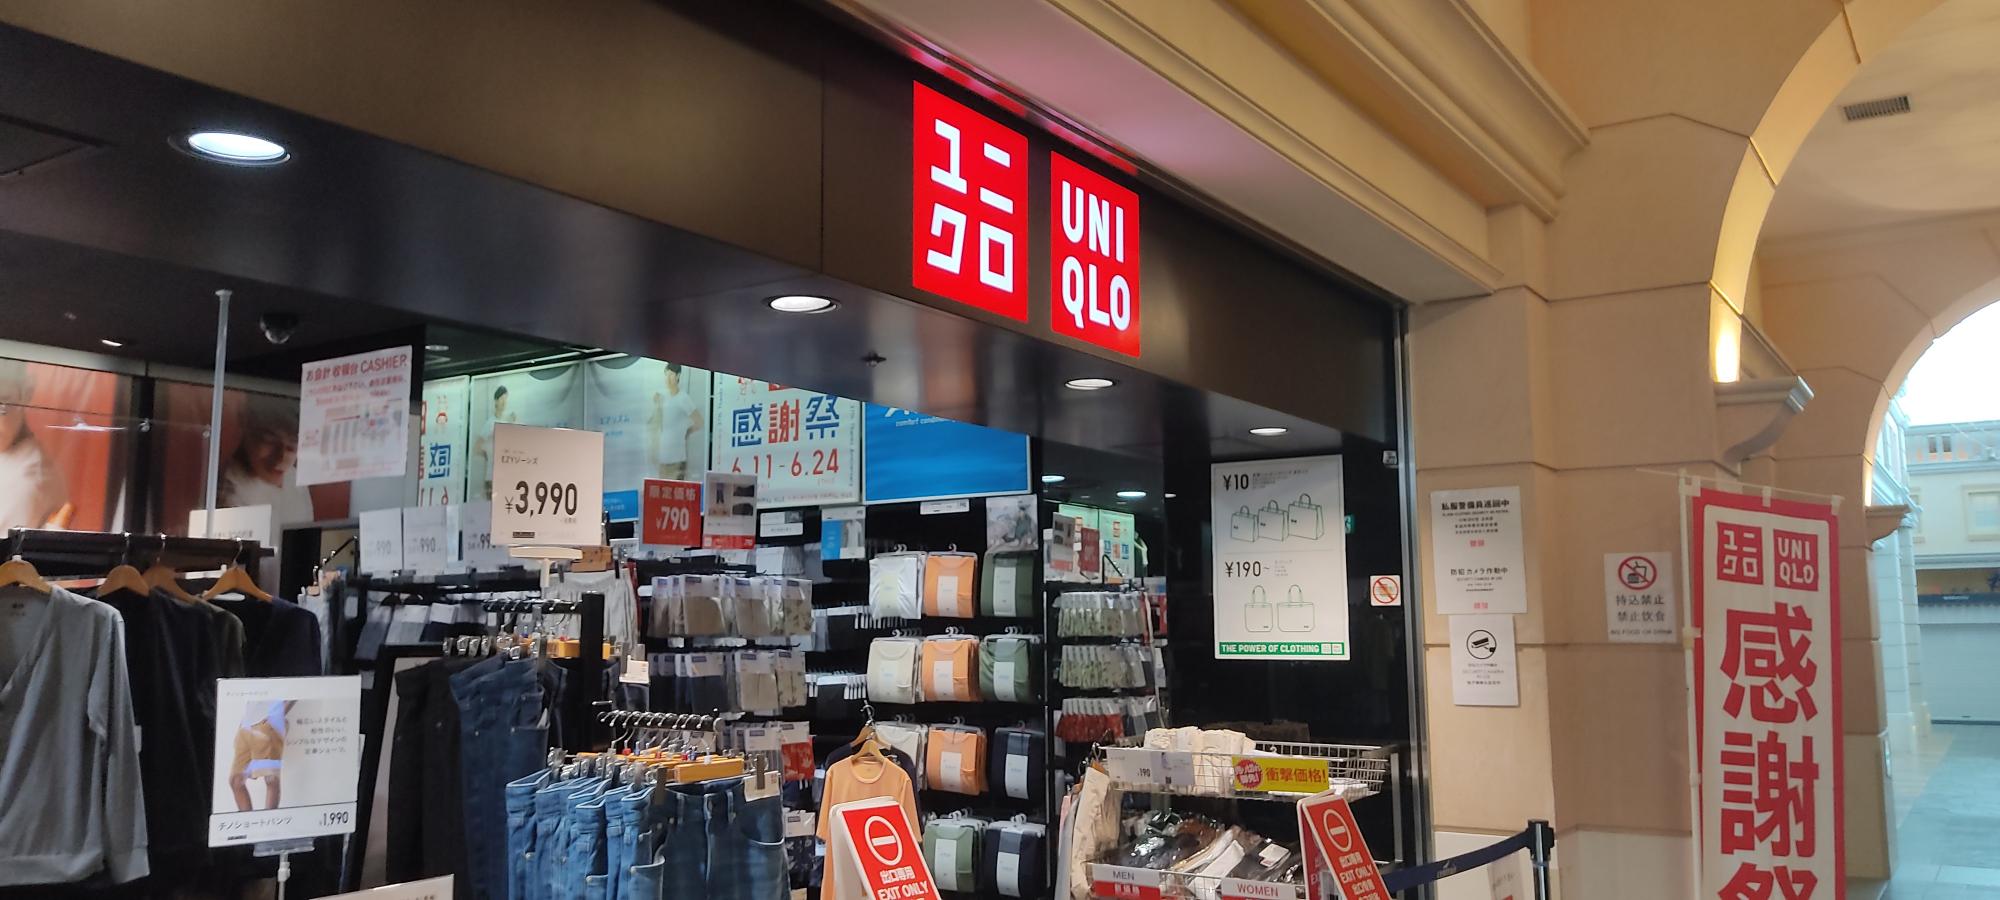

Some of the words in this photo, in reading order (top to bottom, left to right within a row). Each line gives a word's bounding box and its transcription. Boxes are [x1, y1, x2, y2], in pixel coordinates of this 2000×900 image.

[931, 119, 1013, 214] ユニ
[1062, 181, 1124, 263] UNI
[927, 203, 1013, 293] クロ
[1062, 256, 1130, 331] QLO
[732, 395, 840, 448] 感謝祭
[1223, 473, 1249, 491] ¥10
[505, 481, 578, 518] ¥3,990
[656, 506, 690, 531] ¥790
[1723, 530, 1758, 552] ユニ
[1777, 536, 1811, 562] UNI
[1723, 556, 1758, 578] クロ
[1779, 561, 1815, 587] QLO
[1222, 644, 1237, 653] THE
[1238, 644, 1267, 653] POWER
[1268, 643, 1279, 653] OF
[1280, 643, 1319, 653] CLOTHING
[217, 816, 293, 831] チノショートパンツ
[1112, 870, 1135, 880] MEN
[1355, 864, 1374, 879] ONLY
[878, 886, 901, 900] EXIT
[902, 881, 929, 897] ONLY
[1237, 884, 1279, 897] WOMEN
